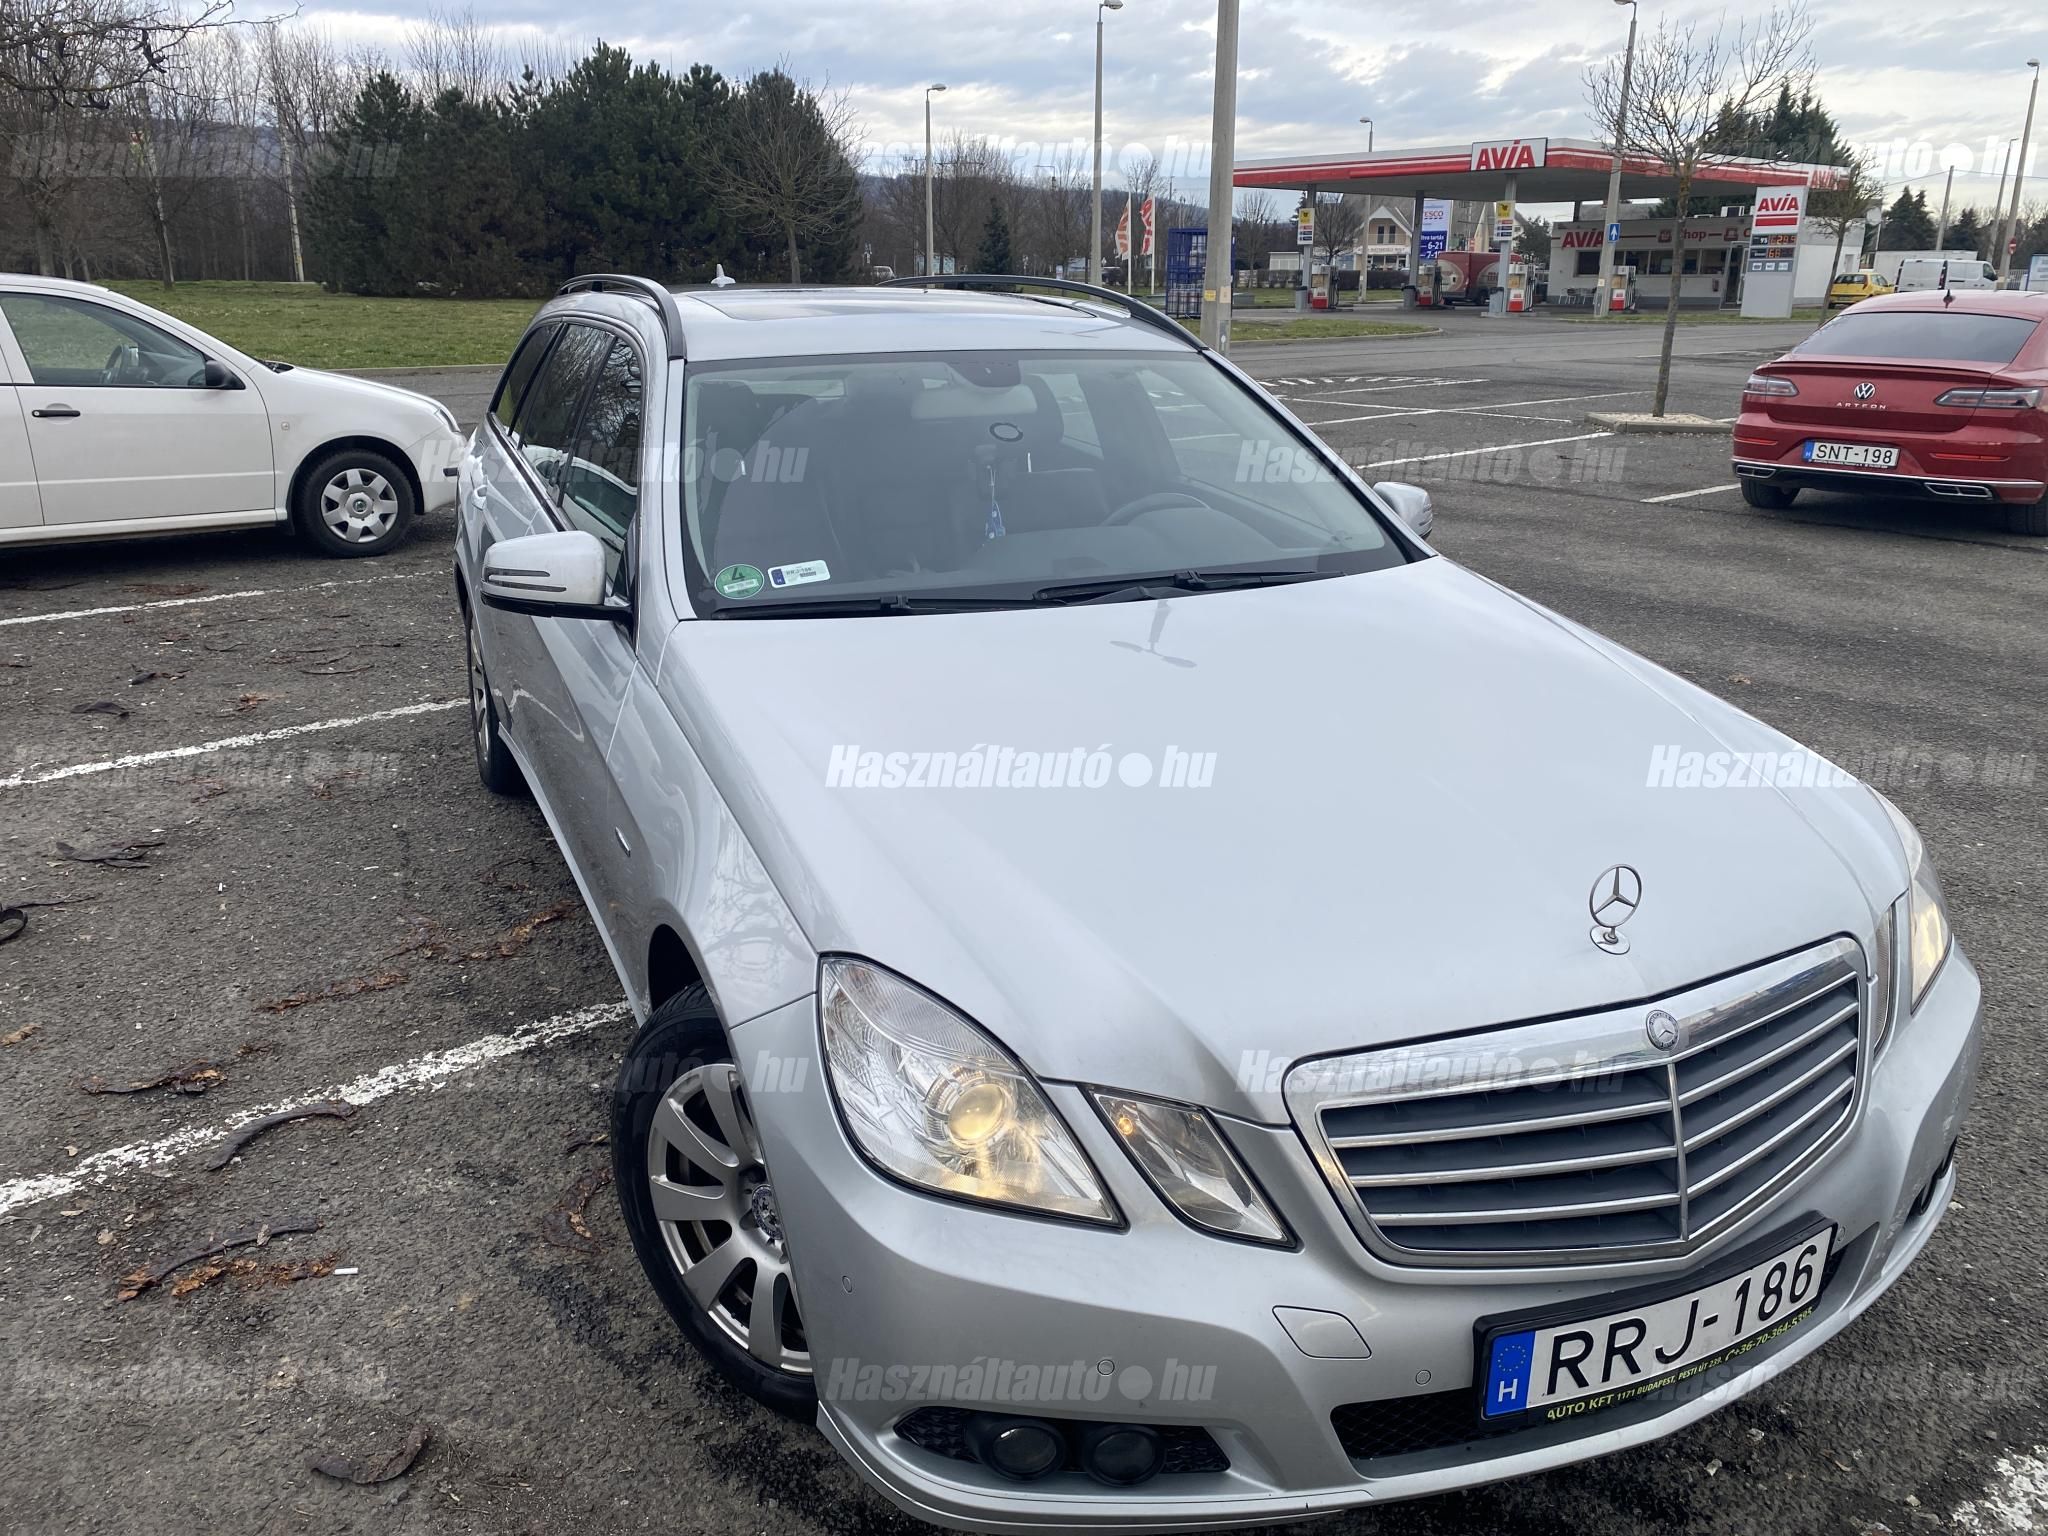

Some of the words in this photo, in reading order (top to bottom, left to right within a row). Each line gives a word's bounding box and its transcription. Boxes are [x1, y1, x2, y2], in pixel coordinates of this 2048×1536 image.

[1836, 402, 1887, 410] ARTEON
[1816, 444, 1893, 464] SNT-198
[1498, 1378, 1518, 1402] H
[1546, 1244, 1818, 1396] RRJ-186
[1547, 1401, 1586, 1420] AUTO
[1588, 1394, 1615, 1410] KFT
[1617, 1390, 1635, 1401] 1171
[1678, 1367, 1697, 1381] PESTI
